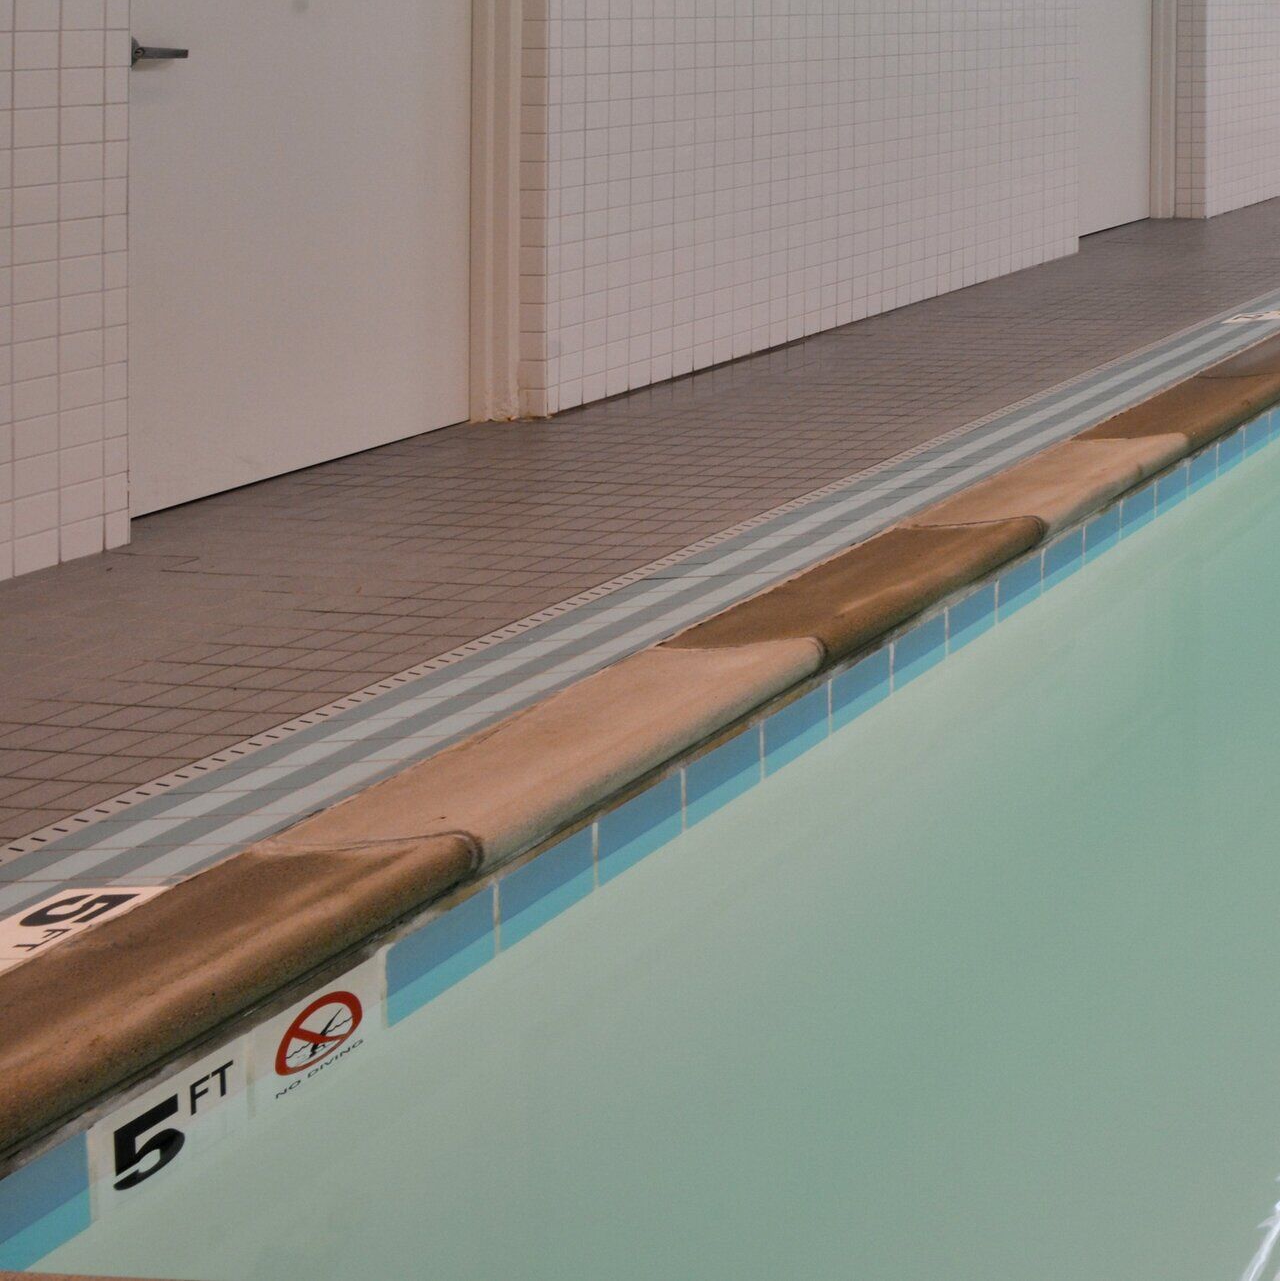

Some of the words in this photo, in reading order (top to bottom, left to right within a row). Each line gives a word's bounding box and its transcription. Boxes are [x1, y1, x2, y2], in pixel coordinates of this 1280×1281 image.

[18, 893, 141, 927] 5
[12, 928, 72, 952] FT
[275, 1080, 302, 1100] NO
[307, 1038, 365, 1079] DIVING
[113, 1093, 186, 1191] 5
[190, 1059, 234, 1116] FT
